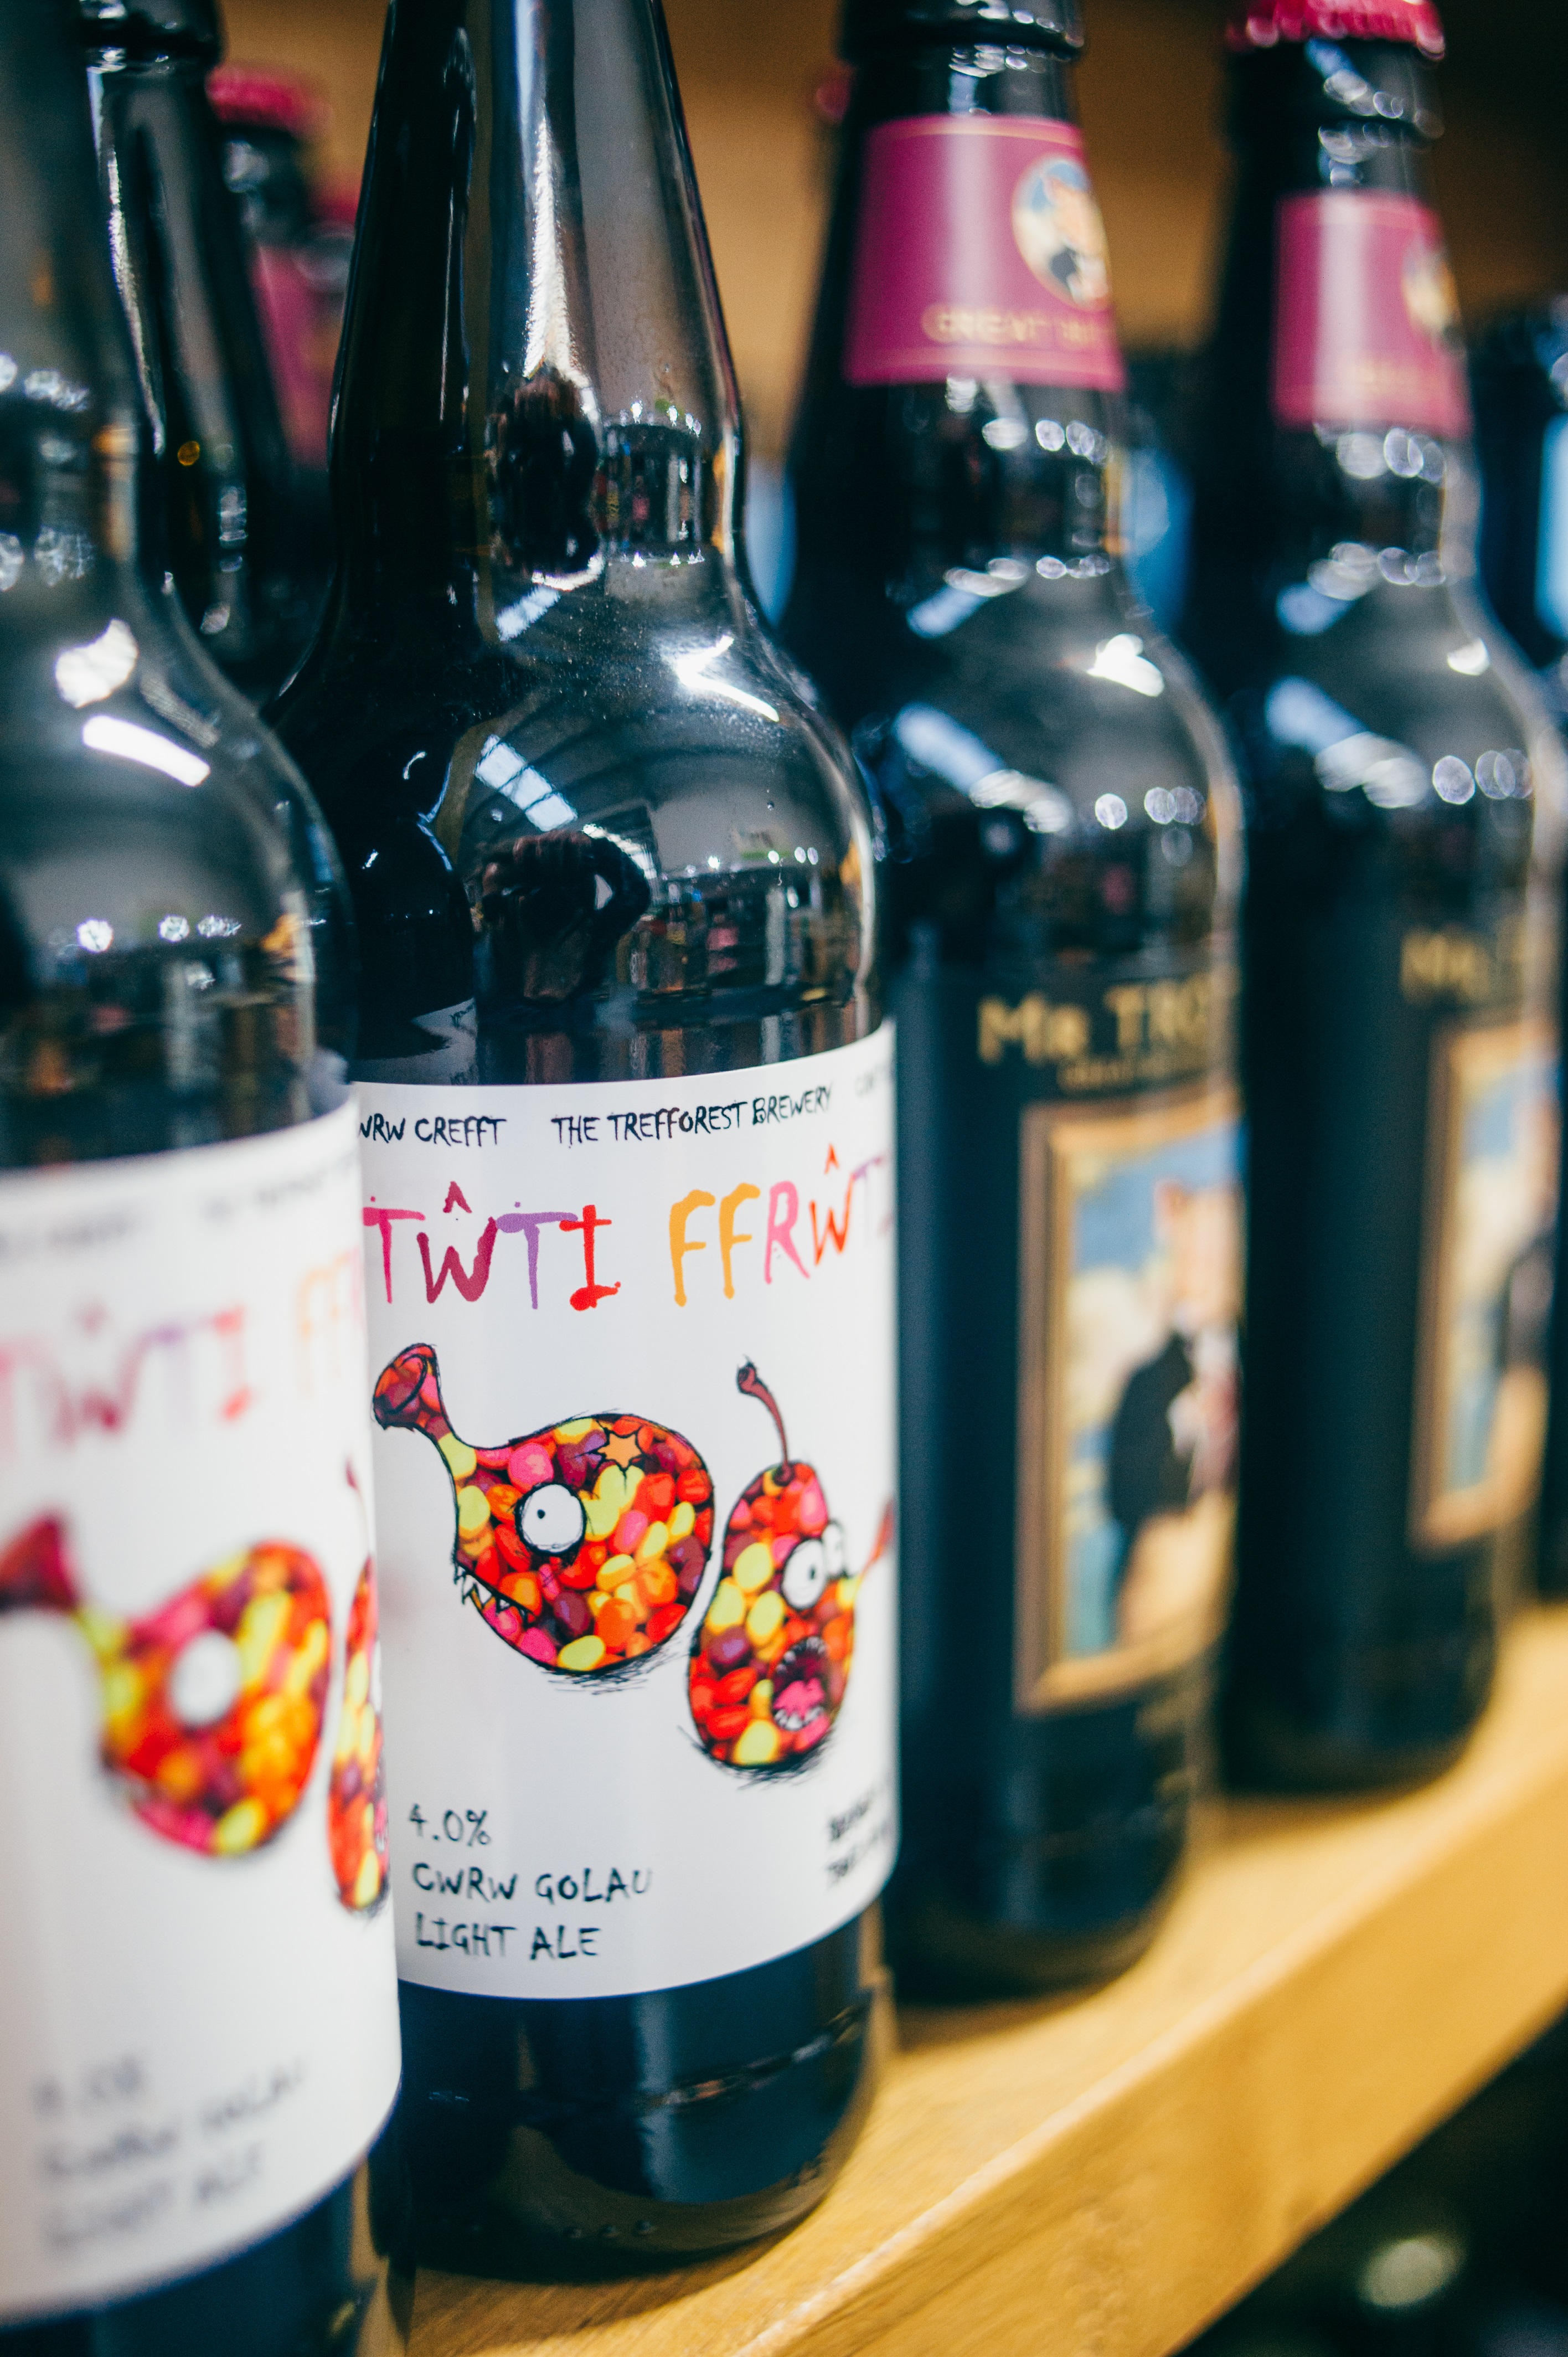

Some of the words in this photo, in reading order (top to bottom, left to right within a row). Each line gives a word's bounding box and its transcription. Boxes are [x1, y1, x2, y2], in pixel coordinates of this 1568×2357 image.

[415, 1115, 506, 1146] CREFFT
[551, 1115, 600, 1148] THE
[607, 1101, 748, 1140] TREFFOREST
[752, 1082, 832, 1125] BREWERY
[409, 1803, 489, 1846] 4.0%
[412, 1863, 518, 1903] CWRW
[535, 1867, 652, 1905] GOLAU
[415, 1912, 517, 1957] LIGHT
[529, 1924, 601, 1960] ALE
